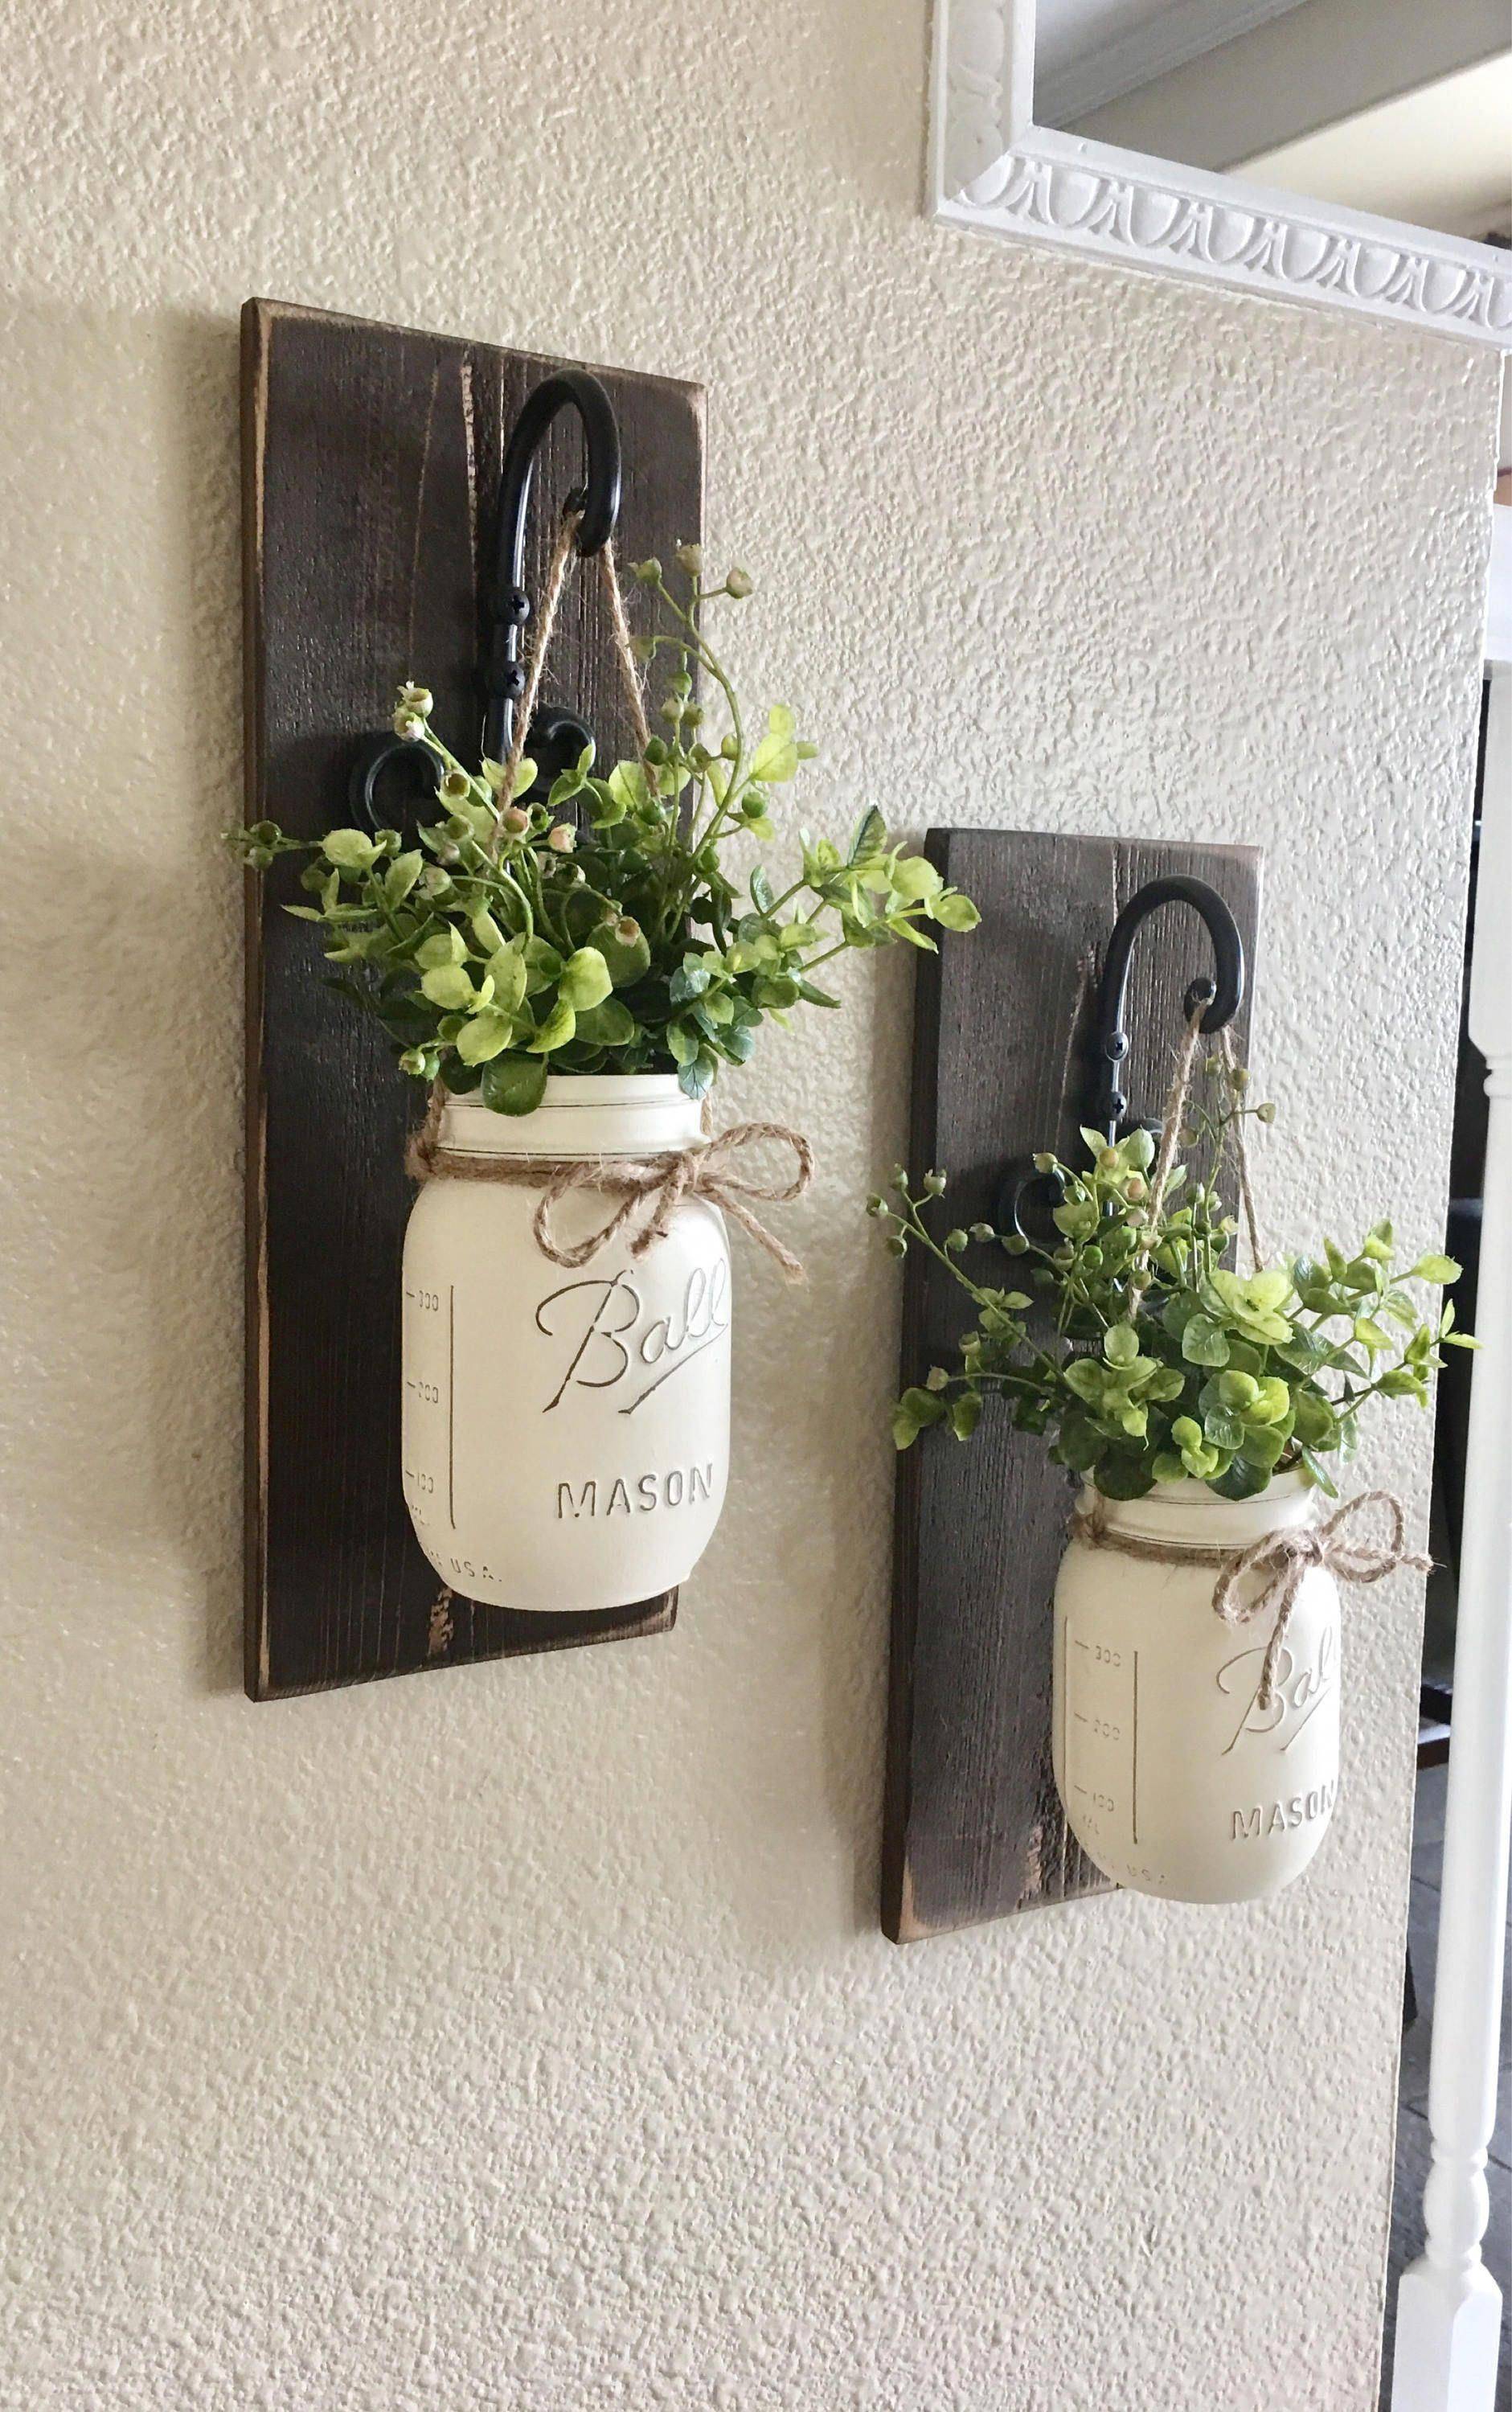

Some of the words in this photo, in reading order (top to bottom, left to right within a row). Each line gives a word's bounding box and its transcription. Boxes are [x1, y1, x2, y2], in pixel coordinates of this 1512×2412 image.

[535, 1257, 728, 1414] Ball
[557, 1462, 713, 1519] MASON
[1215, 1625, 1336, 1756] Bal
[1231, 1778, 1334, 1840] MASON
